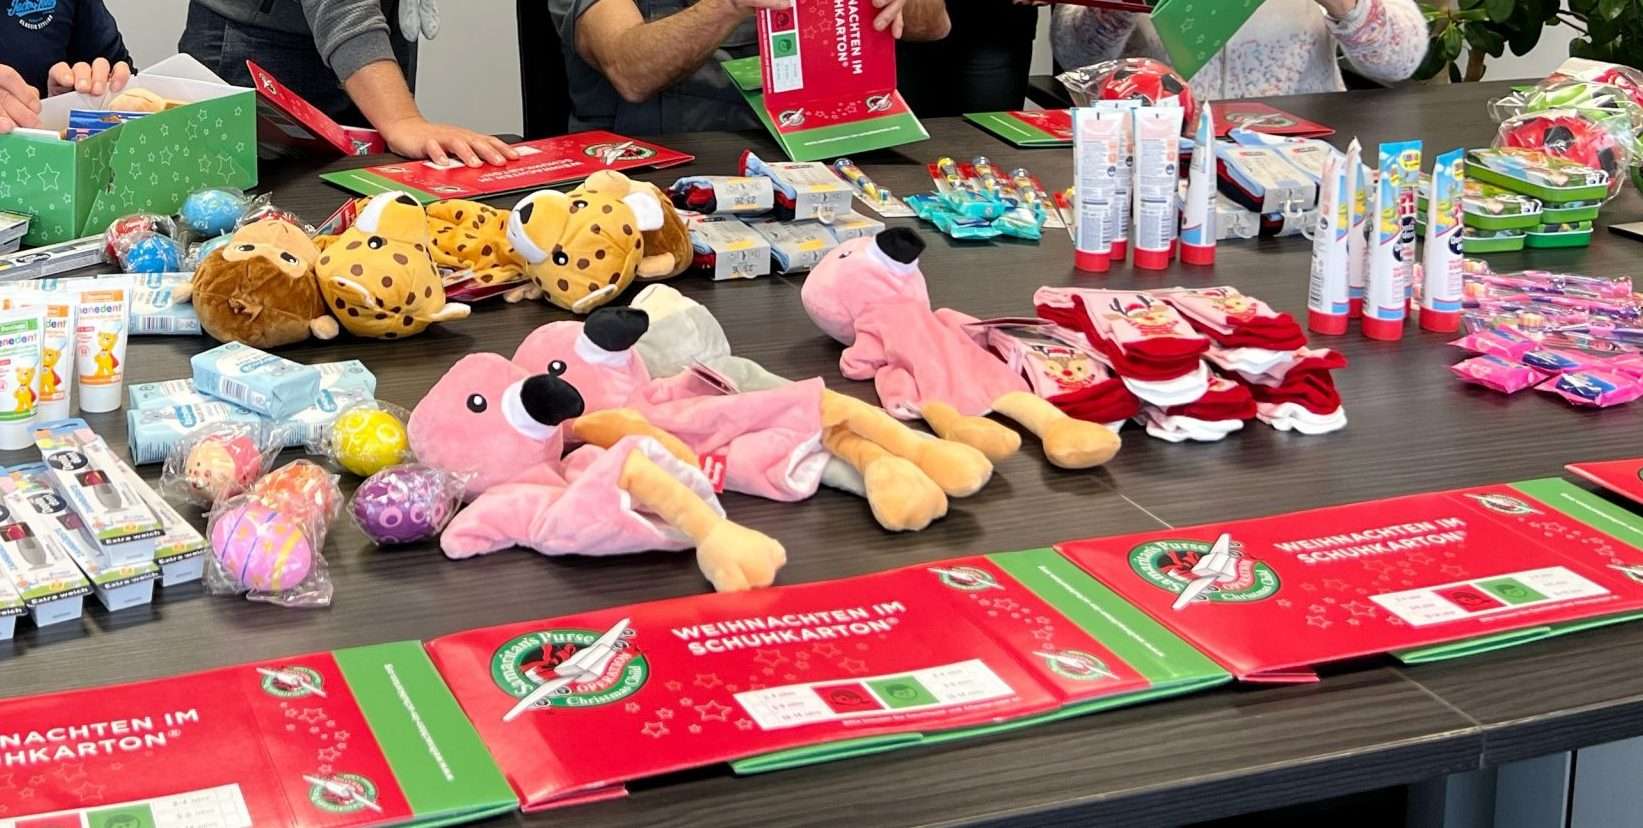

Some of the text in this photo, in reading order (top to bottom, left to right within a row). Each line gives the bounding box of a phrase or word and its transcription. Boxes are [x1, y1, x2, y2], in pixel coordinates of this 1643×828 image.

[851, 61, 863, 75] IM
[106, 530, 160, 545] Extra weich
[1273, 517, 1467, 552] WEIHNACHTEN IM
[104, 579, 130, 589] Extra
[31, 587, 88, 605] Extra weich
[672, 600, 906, 640] WEIHNACHTEN IM
[499, 631, 594, 696] Samaritan's Purse
[566, 685, 632, 706] Christmas
[164, 708, 199, 727] IM
